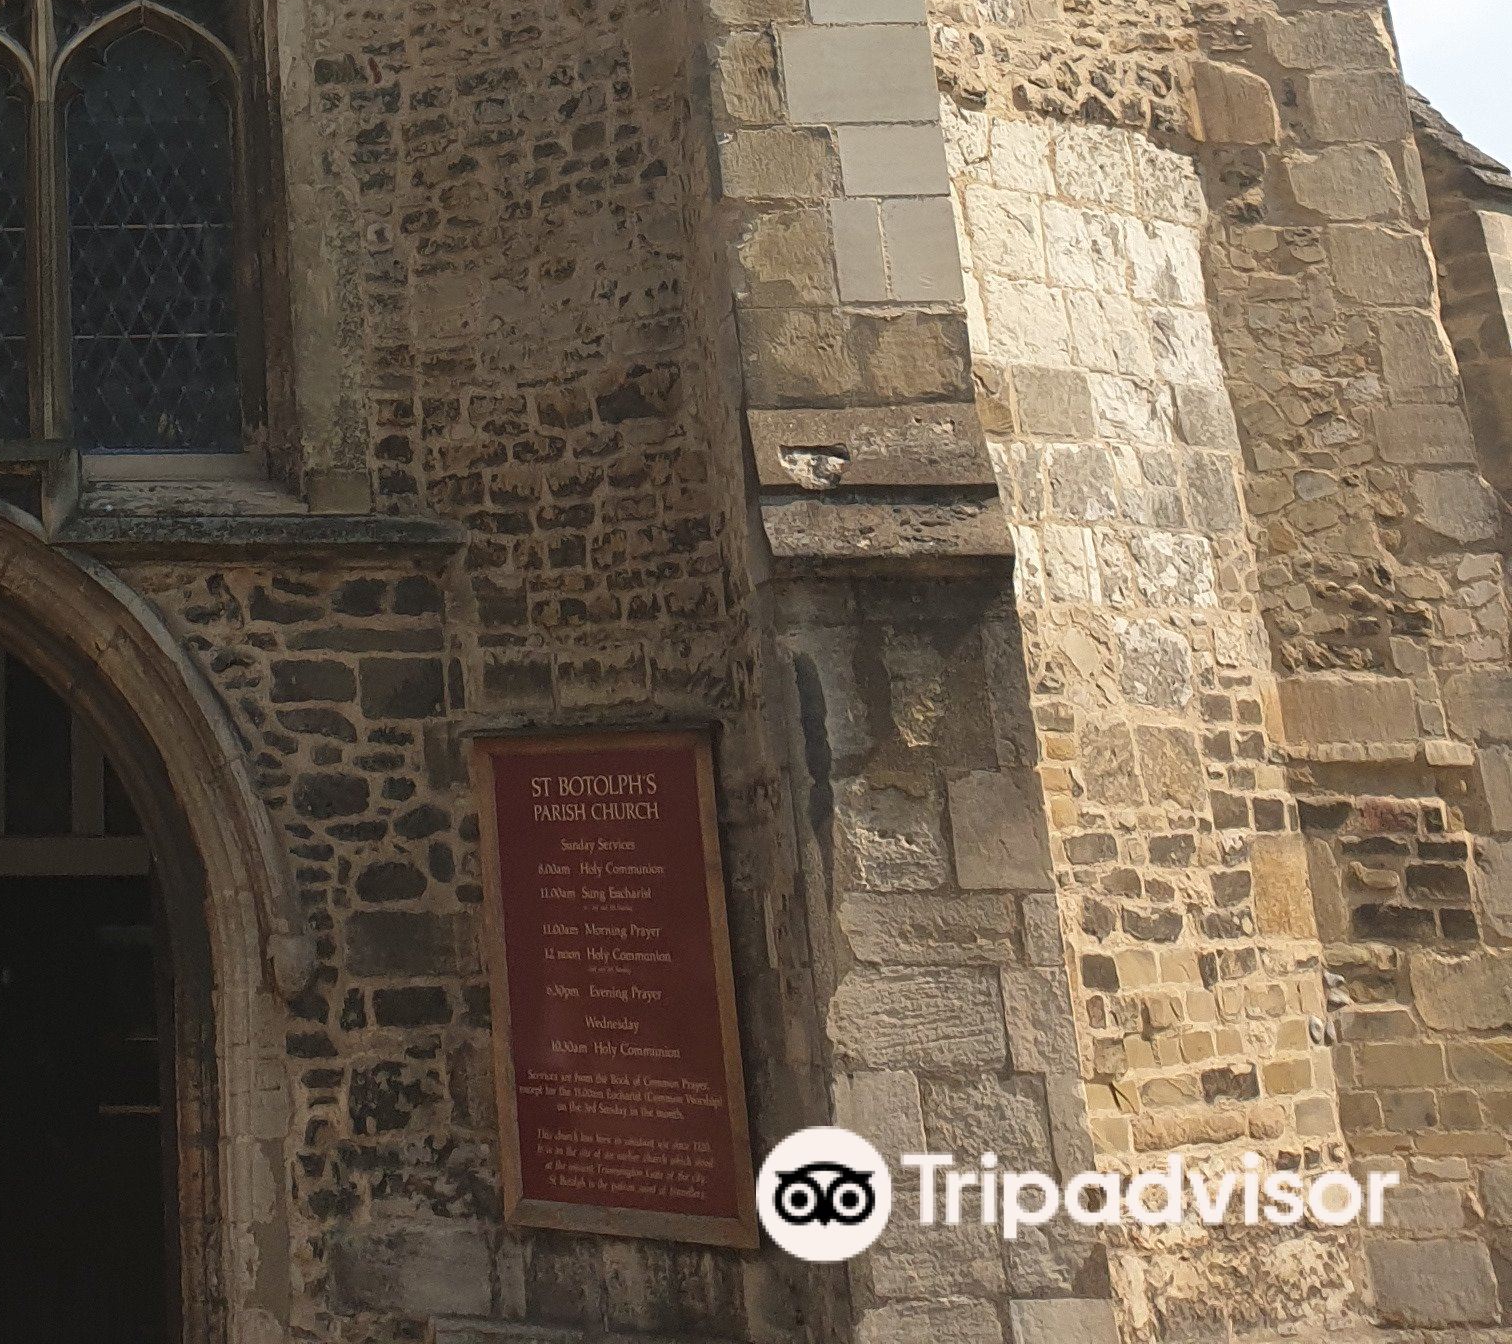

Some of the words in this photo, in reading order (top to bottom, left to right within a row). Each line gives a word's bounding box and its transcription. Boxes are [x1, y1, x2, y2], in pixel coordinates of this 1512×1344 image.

[531, 776, 551, 798] ST
[557, 772, 657, 796] BOTOLPH'S
[534, 803, 586, 822] PARISH
[591, 802, 659, 820] CHURCH
[561, 838, 594, 854] Sunday
[598, 838, 636, 852] Services
[580, 861, 602, 877] Holy
[606, 861, 664, 875] Communion
[582, 886, 606, 903] Sung
[585, 923, 628, 939] Morning
[630, 923, 663, 940] Prayer
[587, 947, 609, 963] Holy
[612, 947, 671, 962] Communion
[589, 984, 628, 1002] Evening
[630, 985, 662, 1002] Prayer
[585, 1015, 640, 1034] Wednesday
[594, 1041, 617, 1058] Holy
[619, 1042, 680, 1059] Communion
